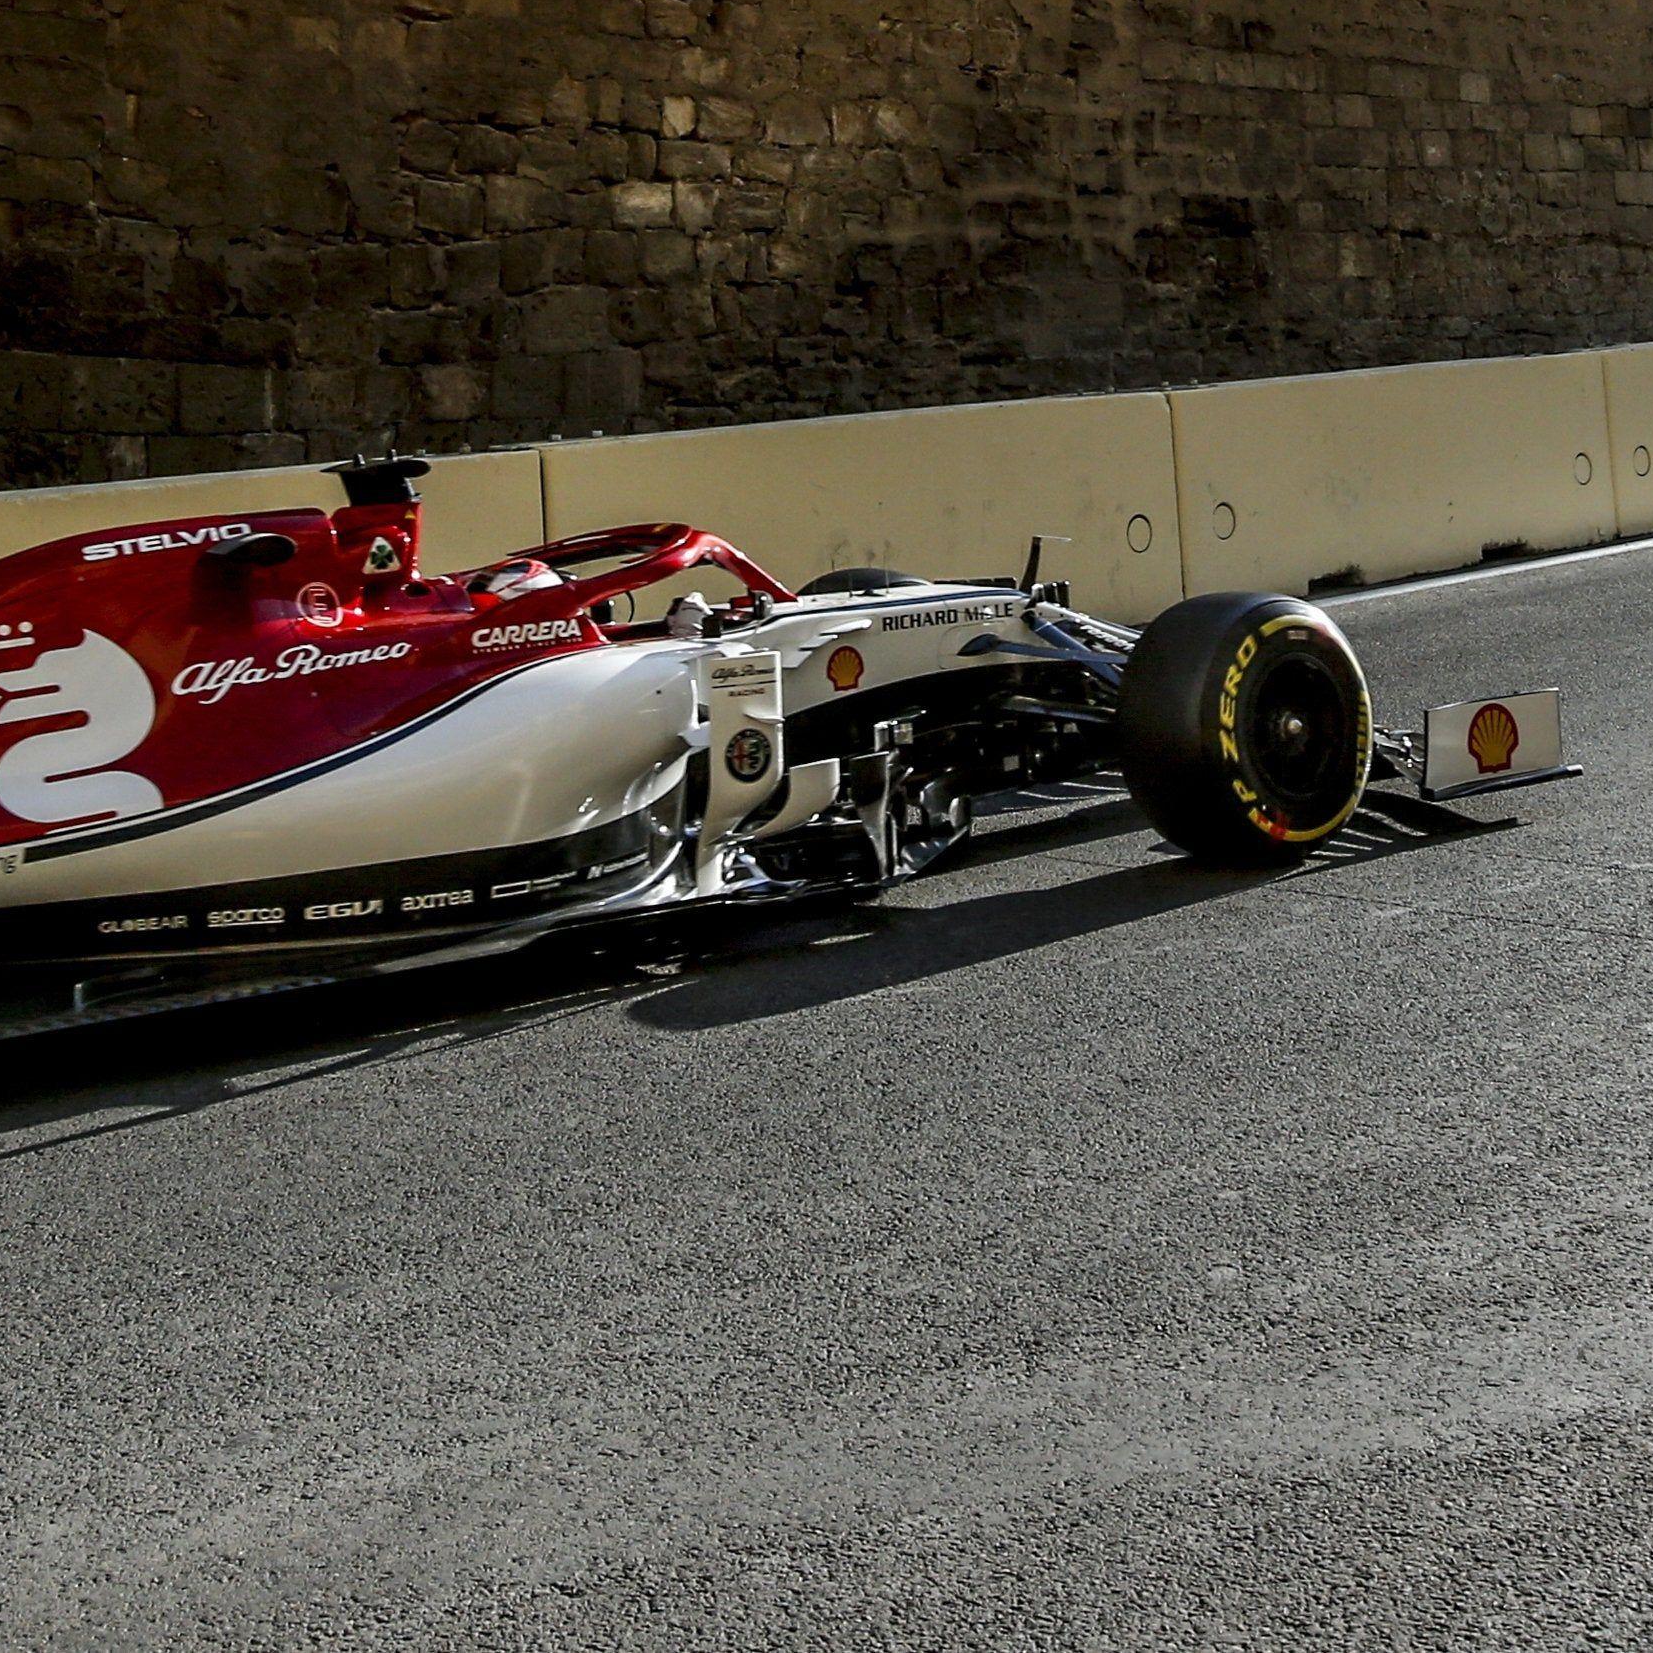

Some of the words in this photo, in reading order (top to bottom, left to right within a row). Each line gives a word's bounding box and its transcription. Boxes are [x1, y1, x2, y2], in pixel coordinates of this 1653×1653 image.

[81, 523, 252, 561] STELVIO
[471, 619, 582, 647] CARRERA
[882, 609, 958, 632] RICHARD
[964, 602, 1013, 622] MILE
[171, 657, 275, 704] Alfa
[274, 643, 413, 679] Romeo
[1219, 635, 1257, 762] ZERO
[207, 907, 285, 927] sparco
